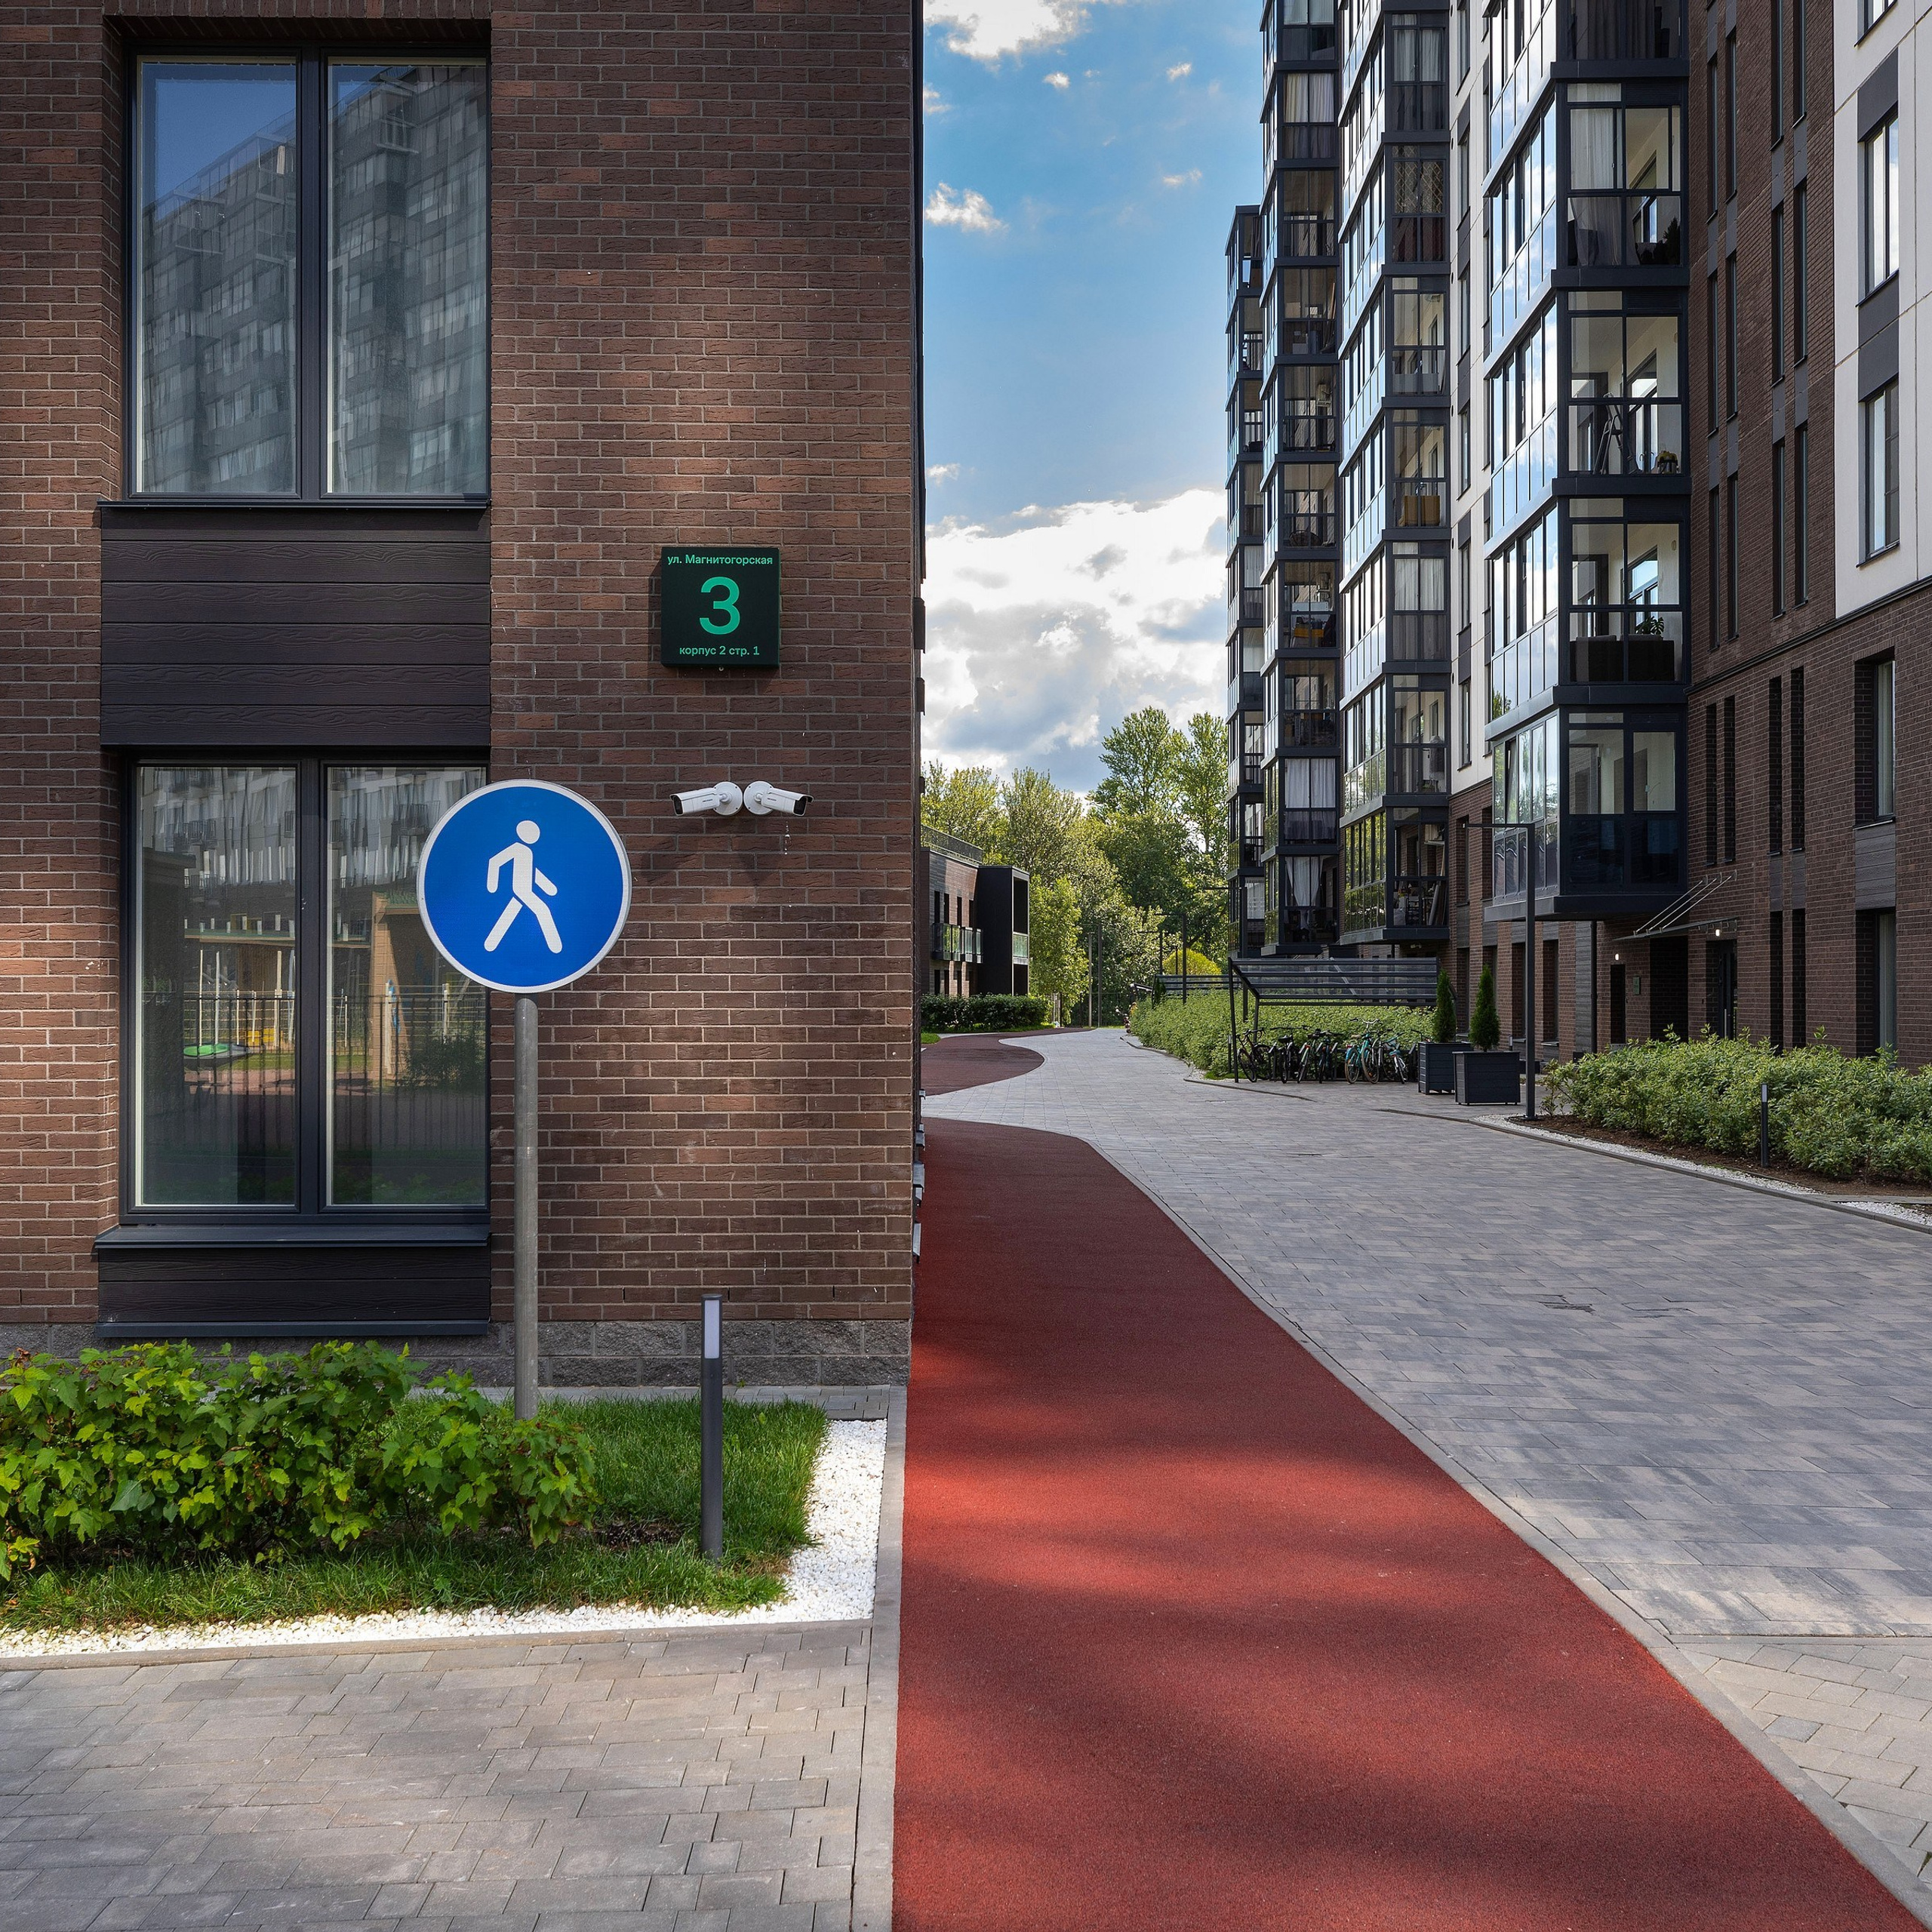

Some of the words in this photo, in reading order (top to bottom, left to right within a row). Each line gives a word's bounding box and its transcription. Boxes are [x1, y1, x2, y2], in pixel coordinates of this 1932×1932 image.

[667, 555, 682, 565] ул.
[685, 555, 773, 566] Магнитогорская
[700, 577, 740, 635] 3
[679, 647, 716, 657] корпус
[719, 646, 726, 655] 2
[728, 648, 749, 657] стр.
[753, 646, 760, 655] 1
